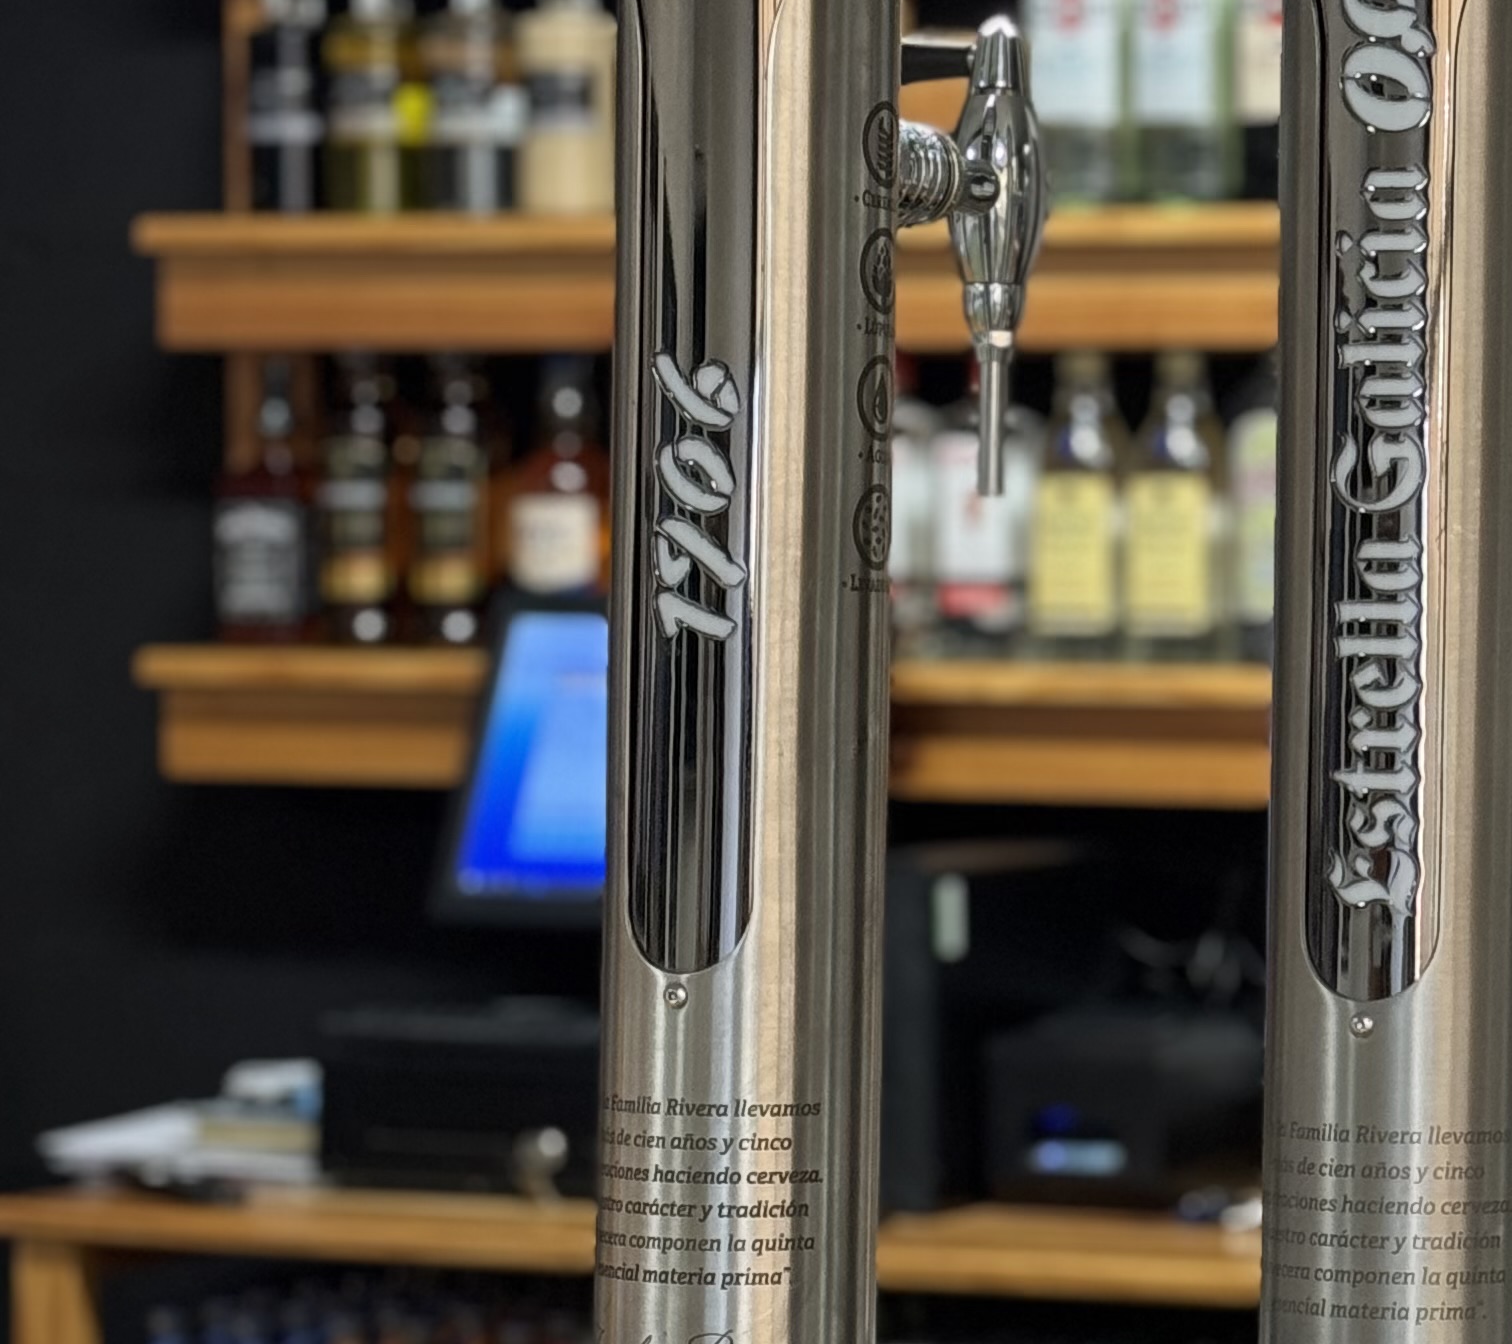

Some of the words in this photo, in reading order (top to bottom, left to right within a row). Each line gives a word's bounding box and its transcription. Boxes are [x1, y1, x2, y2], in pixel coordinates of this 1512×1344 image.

[1331, 167, 1429, 512] Galicia
[1327, 536, 1422, 917] Estrella
[611, 1094, 661, 1115] Familia
[665, 1097, 728, 1118] Rivera
[734, 1099, 821, 1118] llevamos
[617, 1127, 631, 1146] de
[634, 1129, 666, 1149] cien
[670, 1132, 717, 1151] años
[719, 1136, 734, 1156] y
[738, 1133, 793, 1152] cinco
[1290, 1121, 1350, 1143] Familia
[1355, 1124, 1422, 1145] Rivera
[1428, 1126, 1511, 1145] llevamos
[653, 1164, 741, 1184] haciendo
[746, 1168, 823, 1185] cerveza.
[1297, 1156, 1315, 1175] de
[1319, 1157, 1356, 1178] cien
[1361, 1160, 1411, 1180] años
[1414, 1164, 1428, 1184] y
[1433, 1161, 1485, 1180] cinco
[624, 1198, 695, 1218] carácter
[699, 1204, 713, 1223] y
[717, 1198, 809, 1218] tradición
[1341, 1194, 1435, 1216] haciendo
[629, 1234, 721, 1255] componen
[728, 1234, 746, 1252] la
[750, 1233, 814, 1256] quinta
[1309, 1229, 1389, 1251] carácter
[1392, 1234, 1407, 1254] y
[1412, 1229, 1501, 1251] tradición
[642, 1267, 716, 1286] materia
[1314, 1266, 1415, 1288] componen
[1421, 1266, 1441, 1285] la
[1446, 1266, 1506, 1290] quinta
[1330, 1302, 1409, 1322] materia
